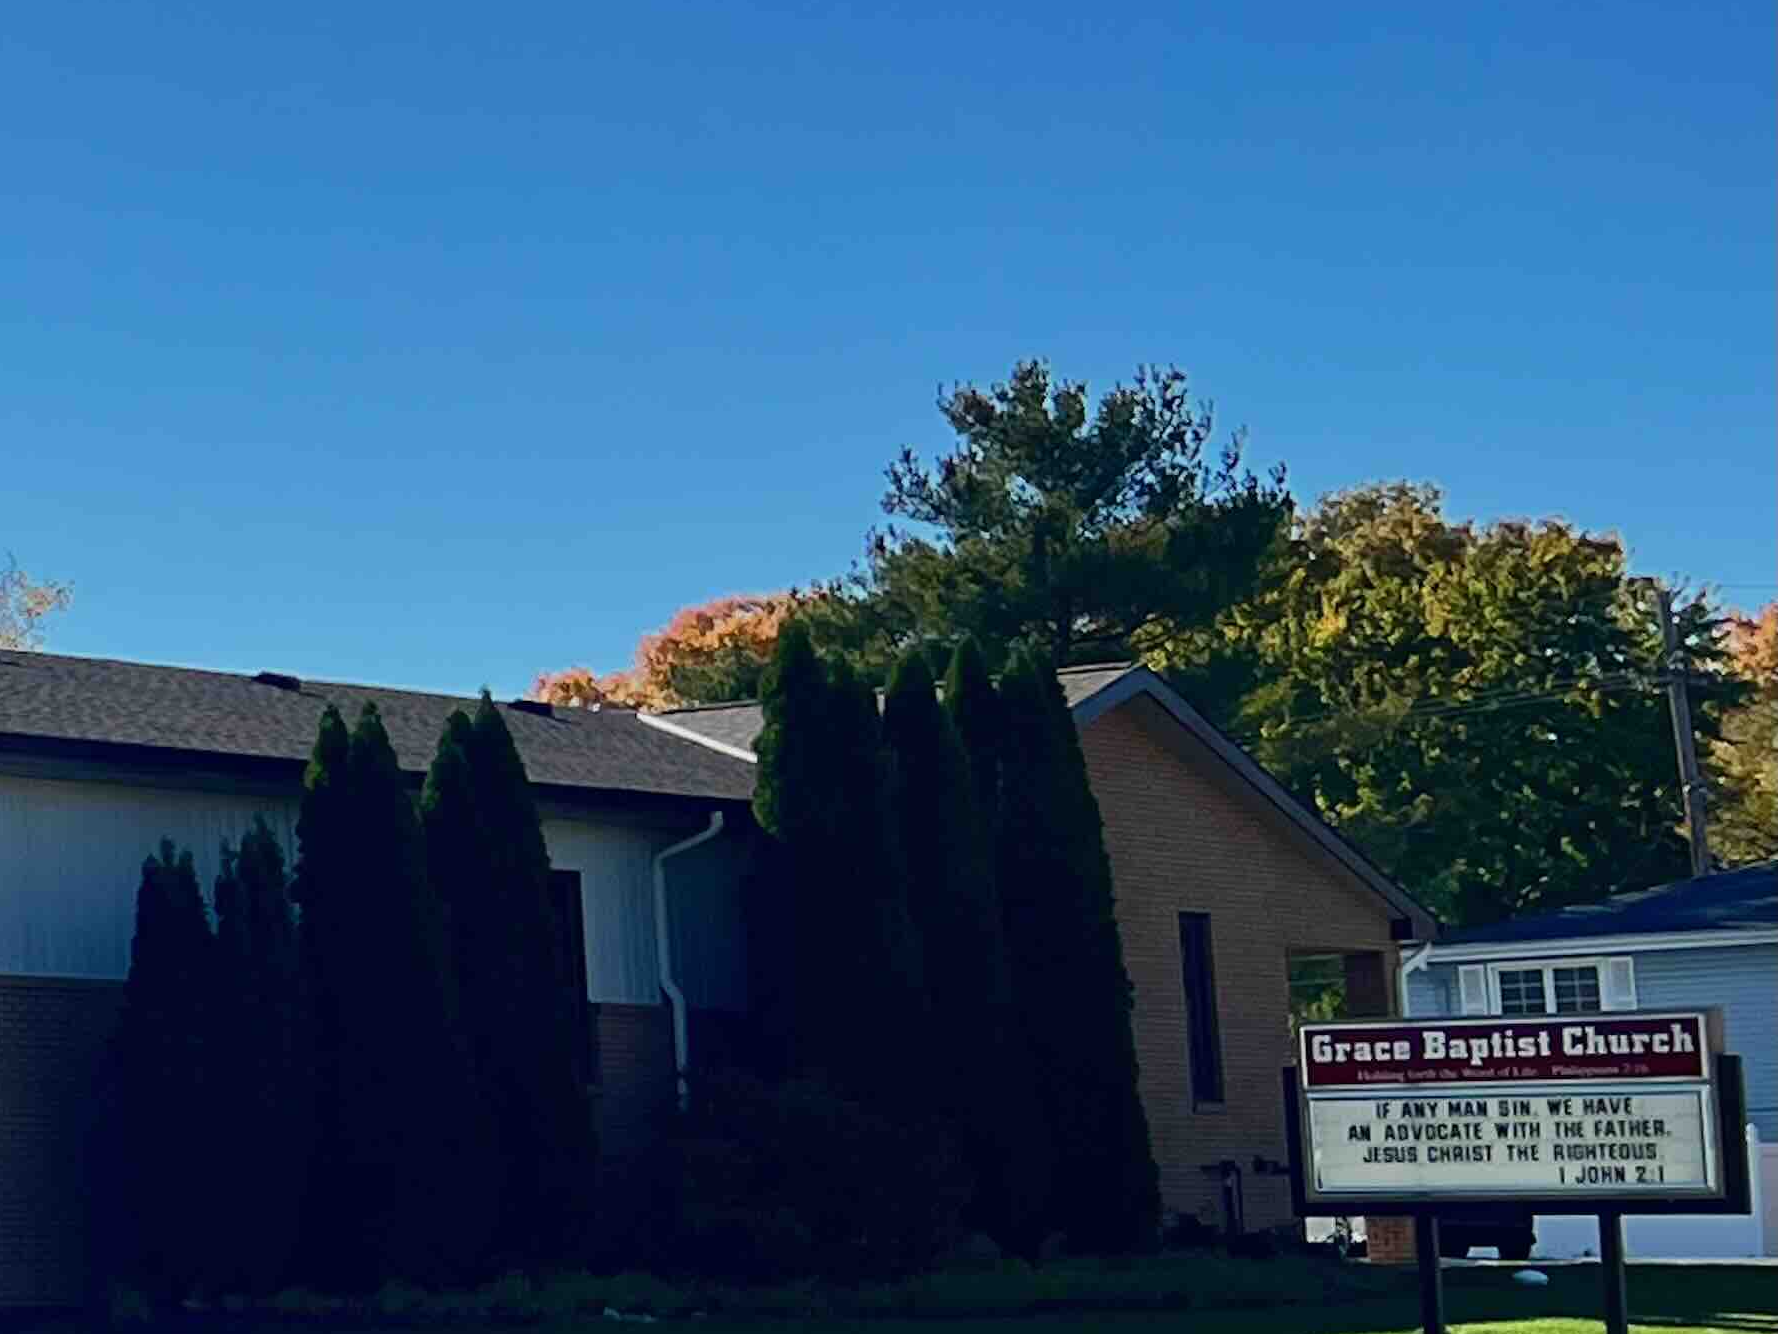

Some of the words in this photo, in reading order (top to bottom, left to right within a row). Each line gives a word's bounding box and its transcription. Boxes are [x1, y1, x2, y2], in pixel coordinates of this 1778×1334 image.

[1312, 1034, 1411, 1063] Grace
[1422, 1029, 1552, 1066] Baptist
[1562, 1023, 1695, 1056] Church
[1375, 1101, 1390, 1118] IF
[1402, 1101, 1438, 1117] ANY
[1448, 1100, 1487, 1116] MAN
[1547, 1098, 1572, 1115] WE
[1583, 1097, 1633, 1115] HAVE
[1348, 1124, 1371, 1141] AN
[1385, 1122, 1482, 1141] ADVOCATE
[1494, 1121, 1540, 1139] WITH
[1555, 1120, 1584, 1138] THE
[1363, 1146, 1418, 1163] JESUS
[1427, 1145, 1492, 1162] CHRIST
[1507, 1144, 1540, 1161] THE
[1575, 1166, 1625, 1184] JOHN
